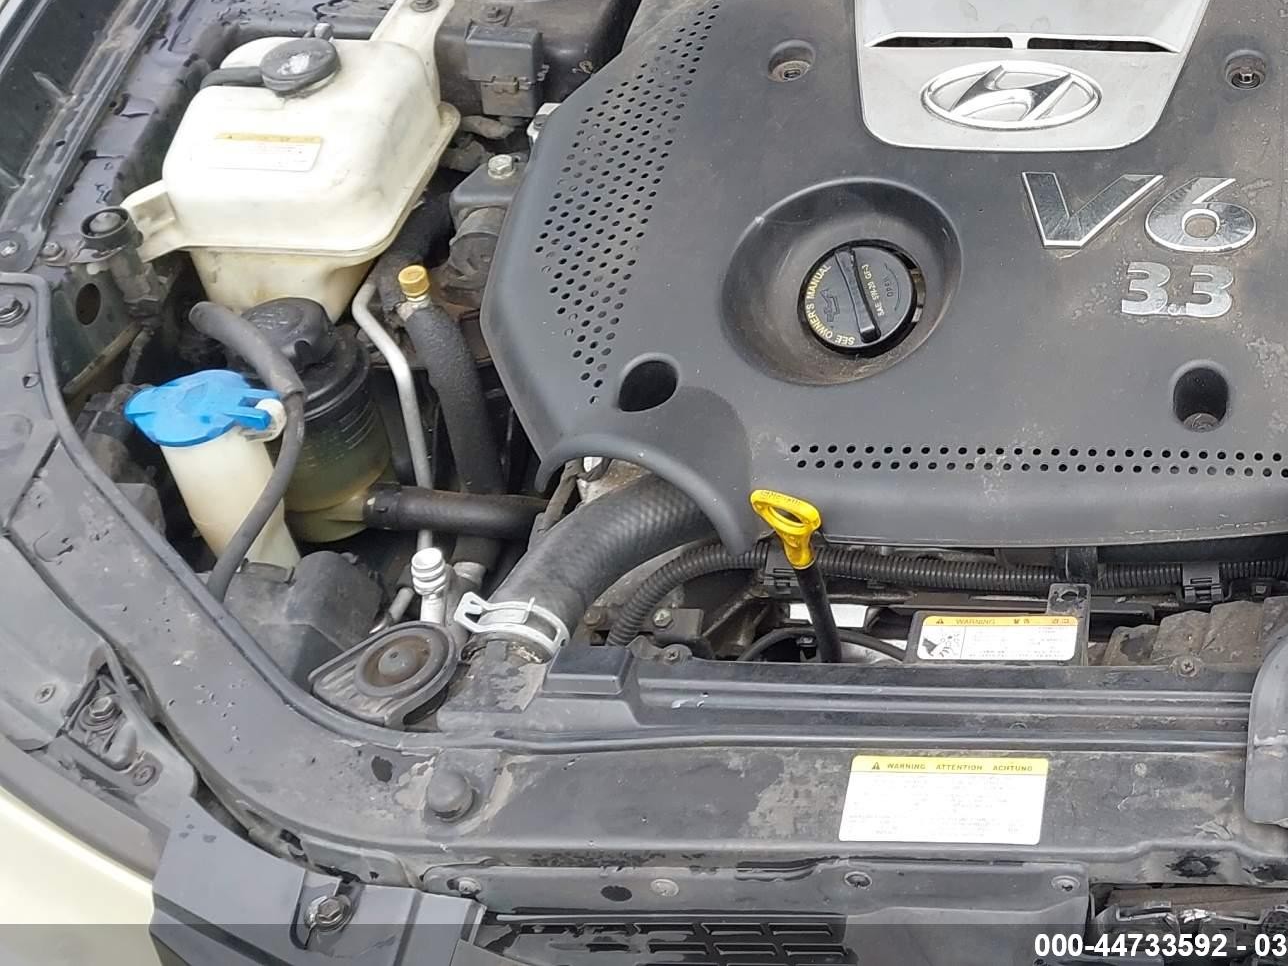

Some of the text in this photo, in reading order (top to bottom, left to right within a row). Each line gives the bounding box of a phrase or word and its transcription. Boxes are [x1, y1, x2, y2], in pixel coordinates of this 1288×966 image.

[1021, 172, 1257, 253] V6
[806, 264, 856, 346] SEE OWNER'S MANUAL
[875, 301, 884, 316] SAE
[1121, 262, 1234, 318] 3.3
[992, 764, 1032, 772] ACHTUNG
